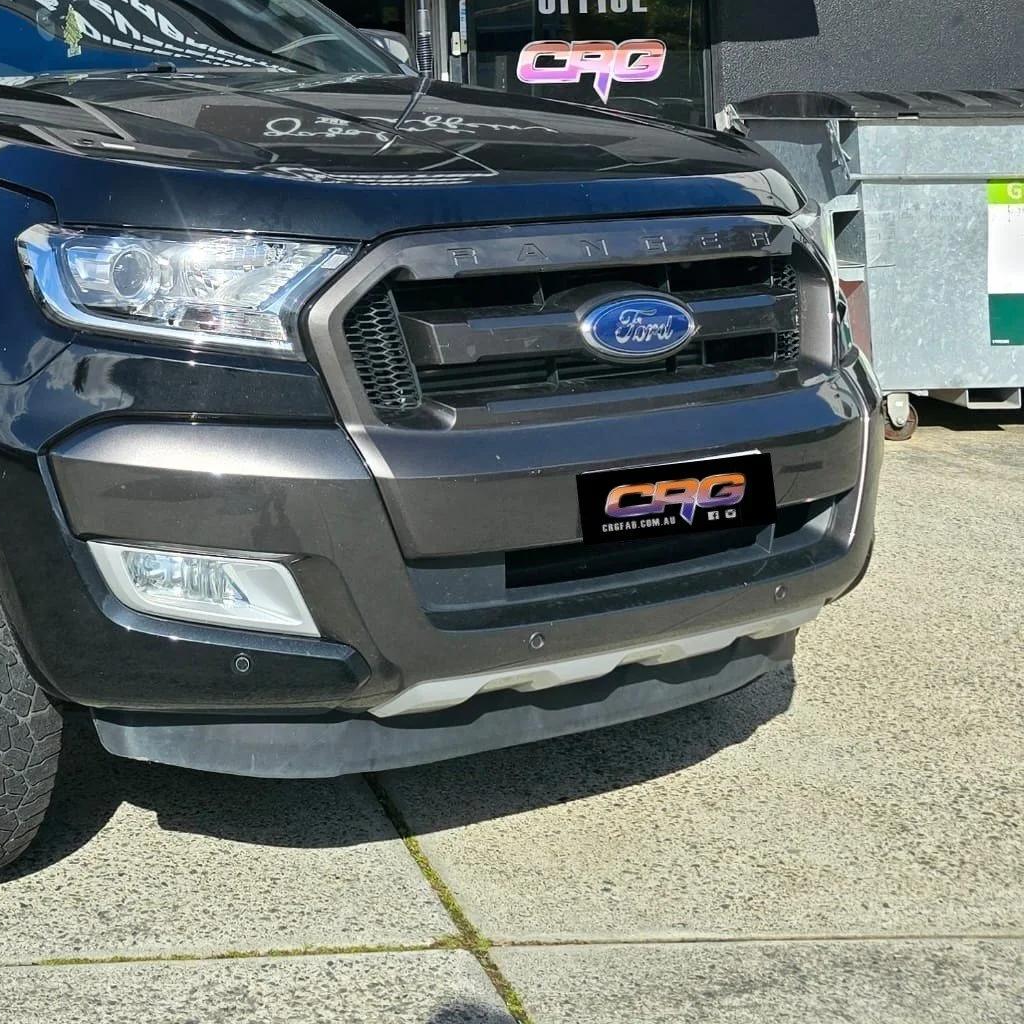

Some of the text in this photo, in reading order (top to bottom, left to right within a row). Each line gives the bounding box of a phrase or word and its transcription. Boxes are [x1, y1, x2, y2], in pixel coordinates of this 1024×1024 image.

[516, 38, 667, 105] CRG
[446, 230, 772, 268] RANGER
[615, 308, 674, 344] Ford
